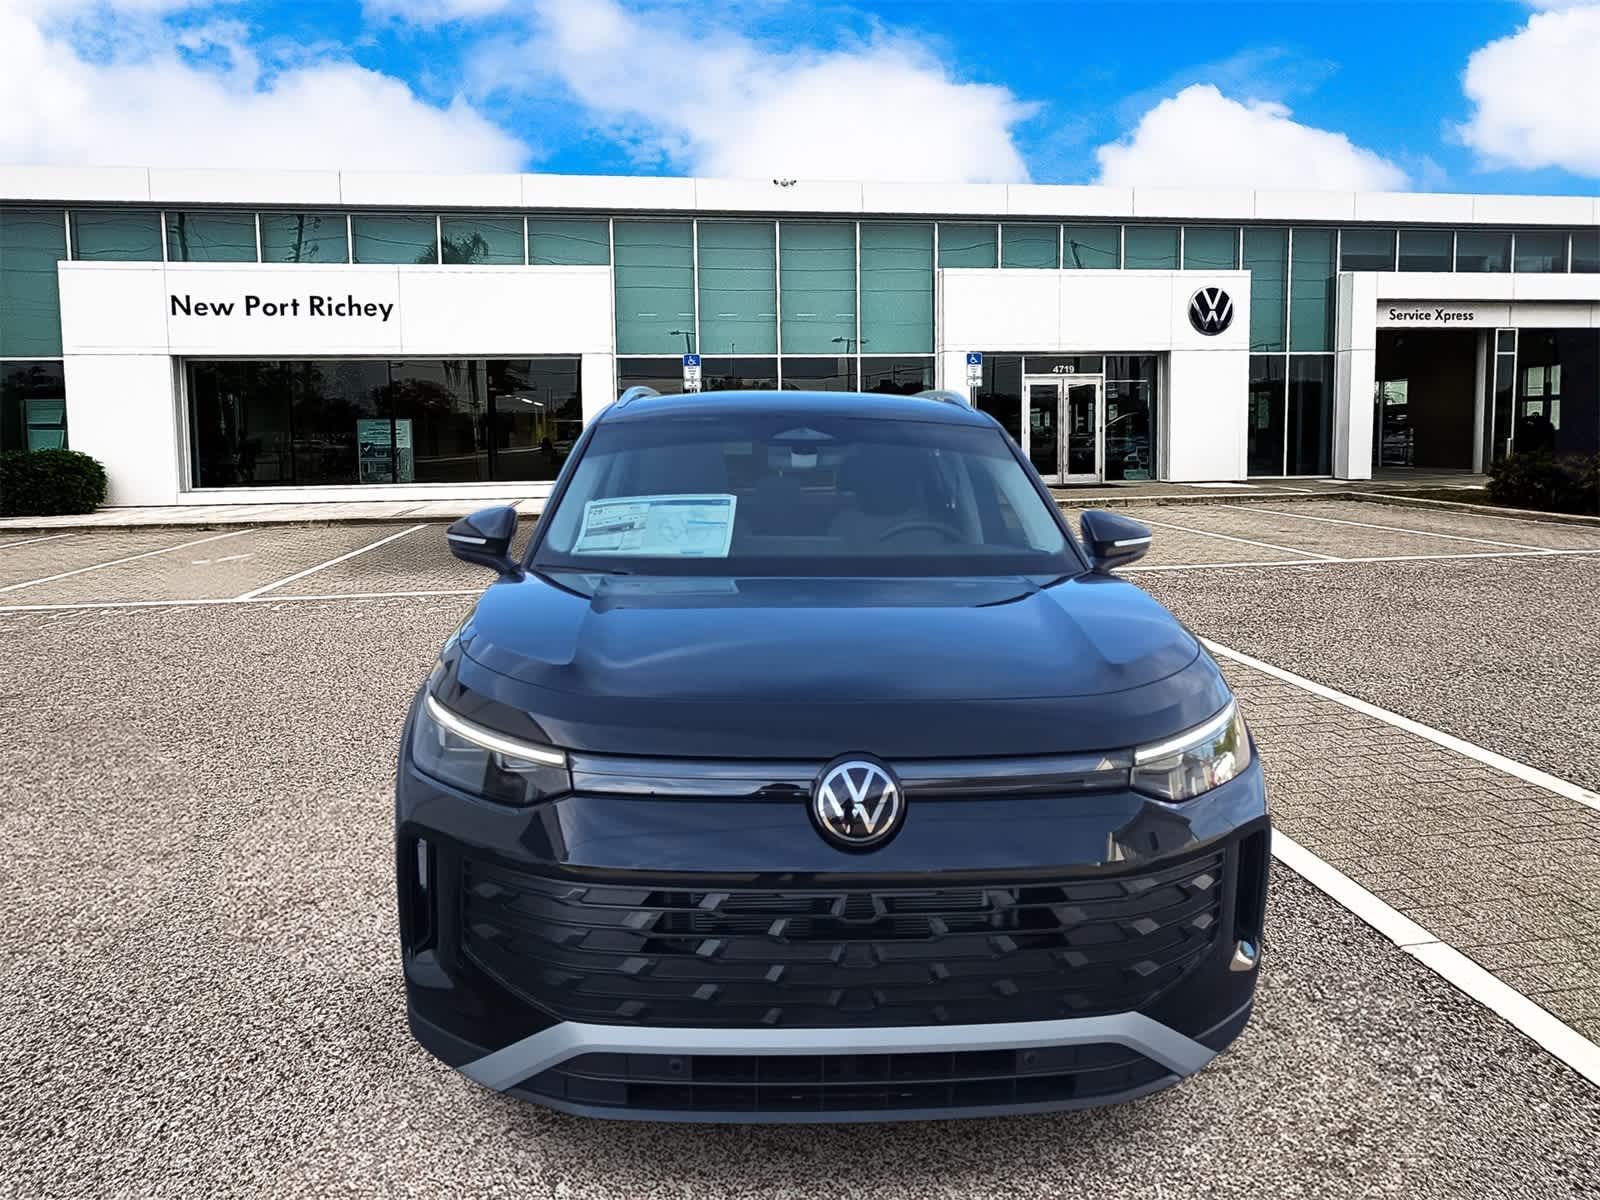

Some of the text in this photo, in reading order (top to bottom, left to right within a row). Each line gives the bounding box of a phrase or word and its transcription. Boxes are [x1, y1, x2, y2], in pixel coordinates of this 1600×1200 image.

[170, 294, 394, 322] New Port Richey
[1190, 287, 1233, 331] VW
[1389, 308, 1474, 324] Service Xpress
[1052, 365, 1075, 374] 4719
[819, 763, 898, 837] VW
